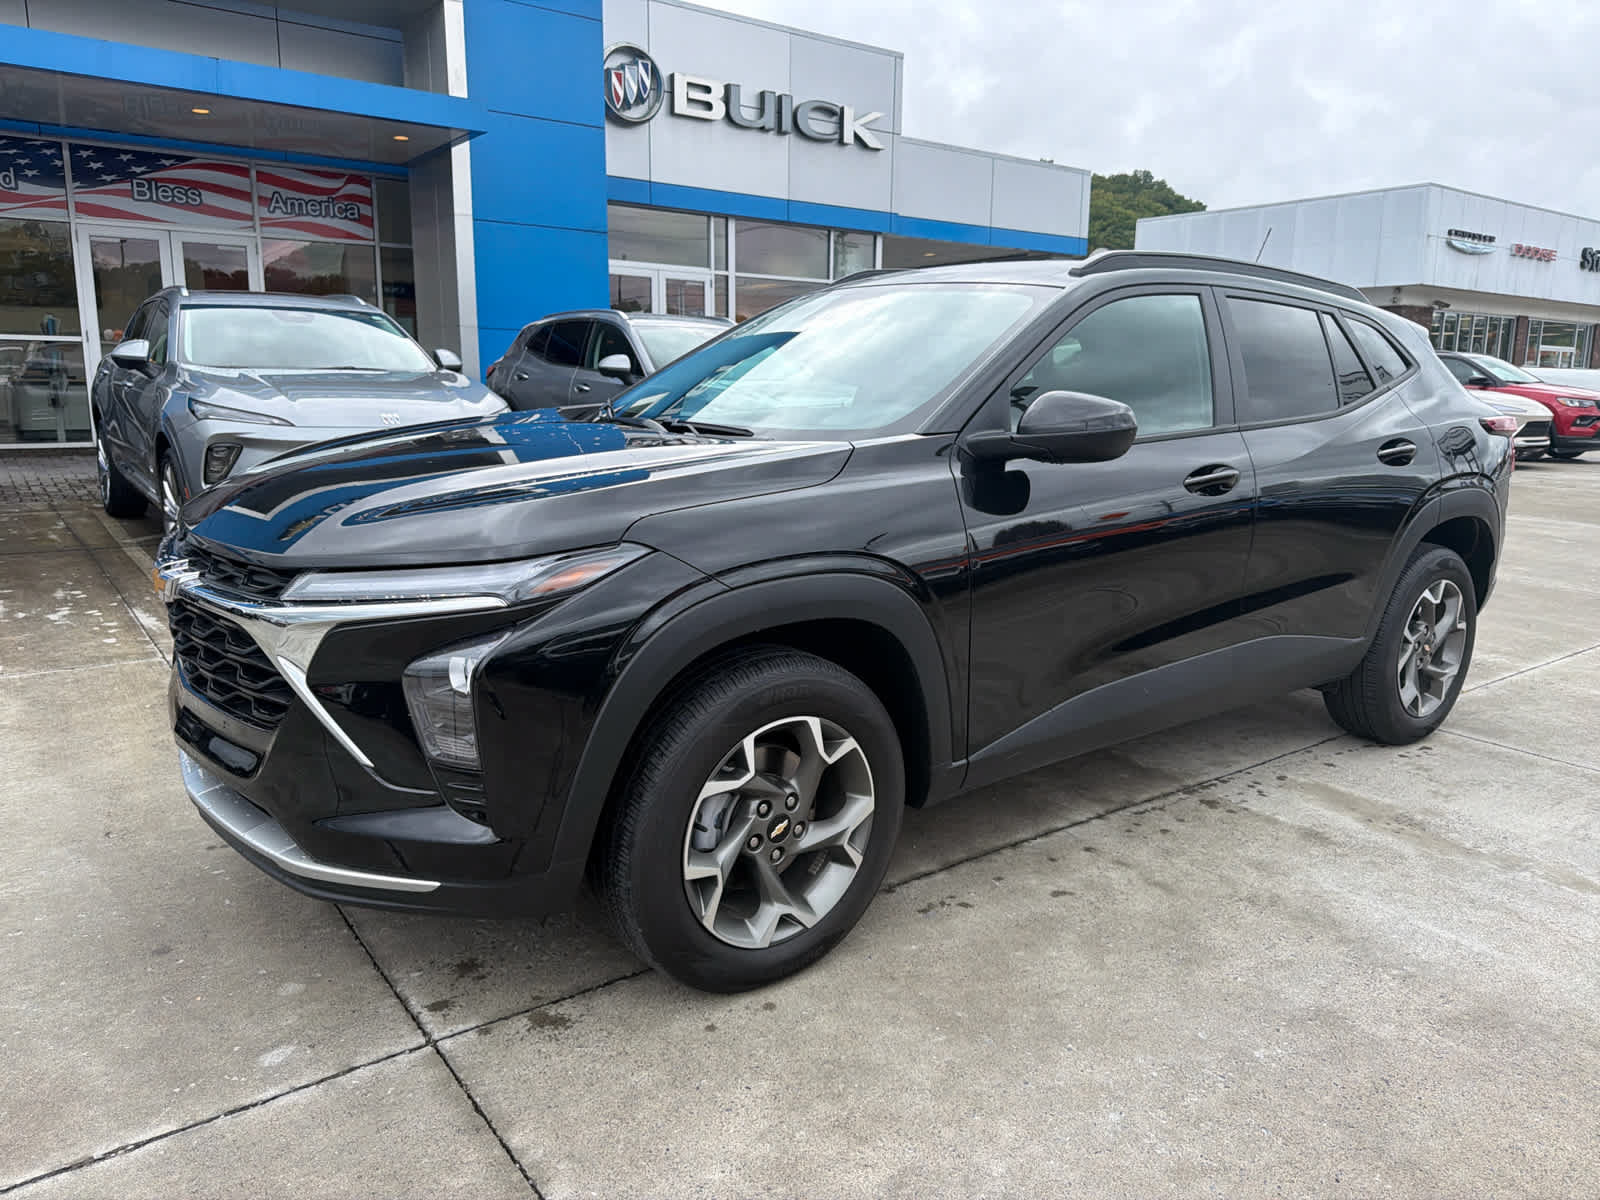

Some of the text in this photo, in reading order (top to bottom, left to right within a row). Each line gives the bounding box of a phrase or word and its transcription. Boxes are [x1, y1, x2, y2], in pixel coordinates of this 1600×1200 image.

[670, 71, 886, 151] BUICK
[131, 178, 202, 206] Bless
[268, 192, 360, 219] America
